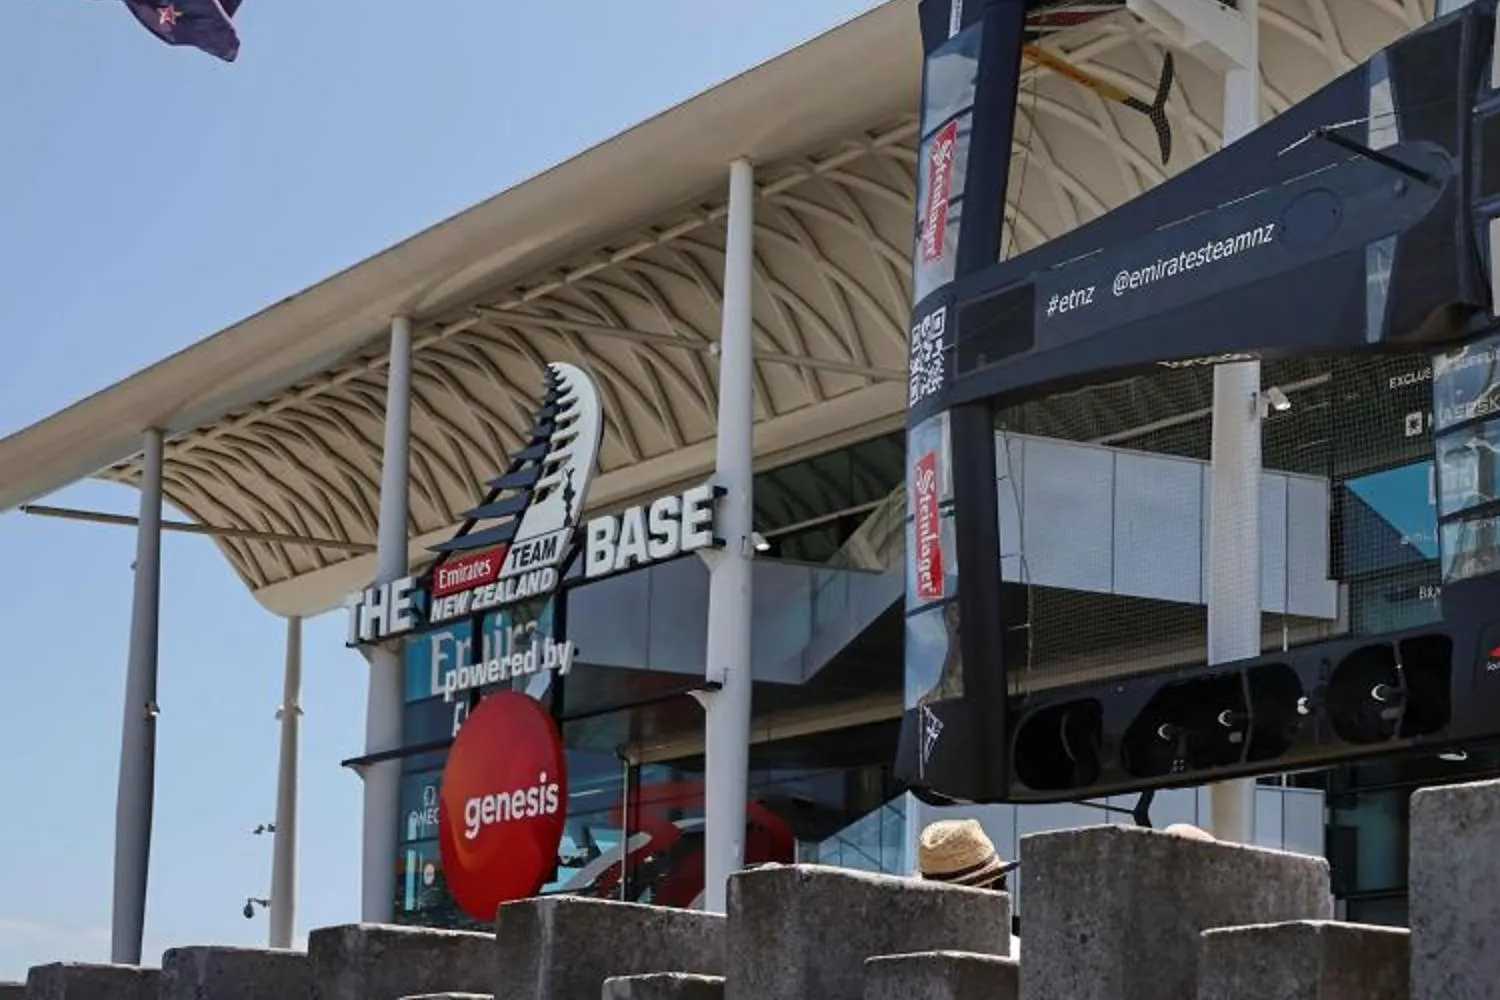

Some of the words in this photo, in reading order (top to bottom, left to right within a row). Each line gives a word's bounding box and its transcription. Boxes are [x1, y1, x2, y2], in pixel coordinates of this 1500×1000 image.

[1047, 284, 1096, 317] #etnz
[1112, 222, 1276, 297] @emiratesteamnz
[511, 536, 558, 570] TEAM
[585, 484, 716, 579] BASE
[429, 595, 469, 624] NEW
[472, 567, 558, 611] ZEALAND
[438, 557, 493, 590] Emirates
[345, 577, 417, 644] THE
[443, 640, 538, 703] powered
[542, 636, 576, 677] by
[409, 807, 440, 825] OMEG
[463, 771, 560, 840] genesis
